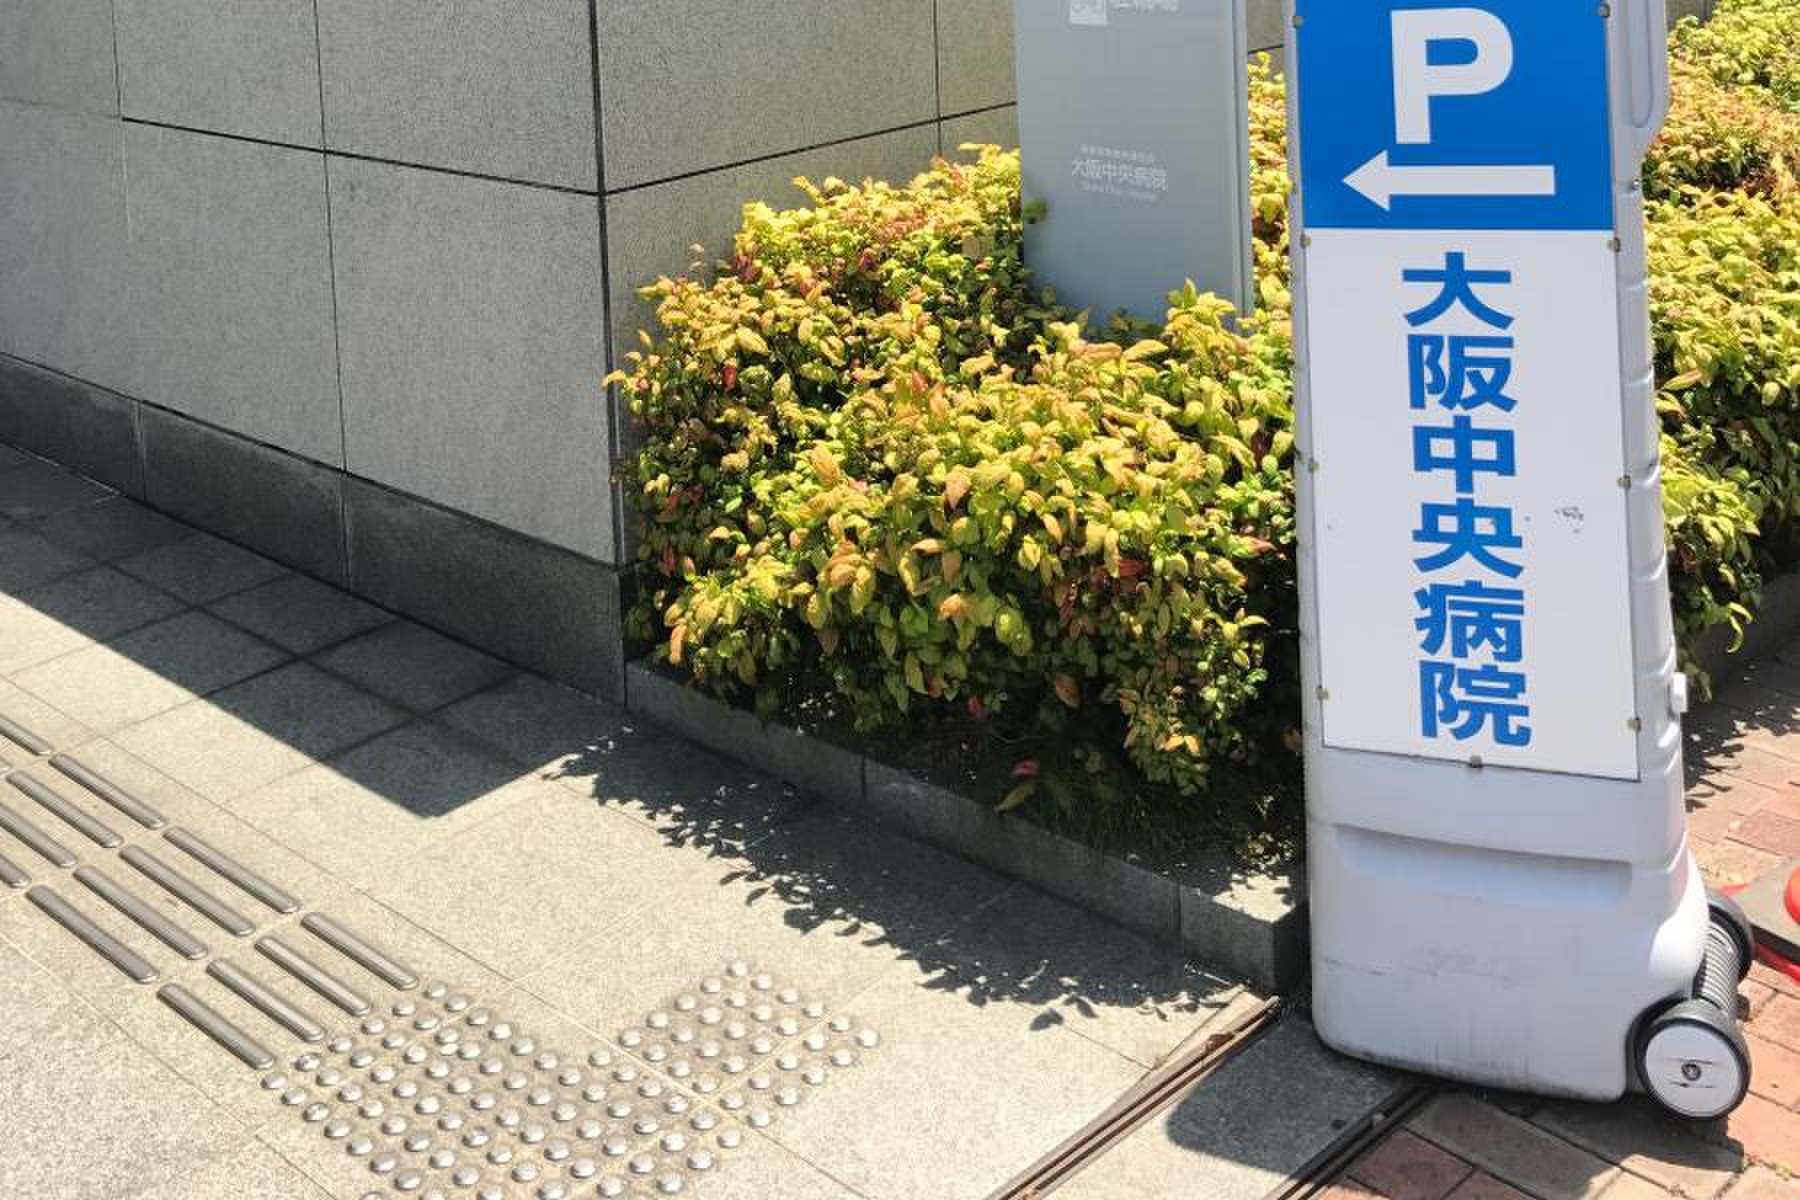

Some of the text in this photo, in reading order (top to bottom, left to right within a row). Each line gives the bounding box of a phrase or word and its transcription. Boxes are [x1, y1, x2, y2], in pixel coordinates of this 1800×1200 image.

[1391, 7, 1514, 144] P
[1402, 251, 1532, 746] 大阪中央病院
